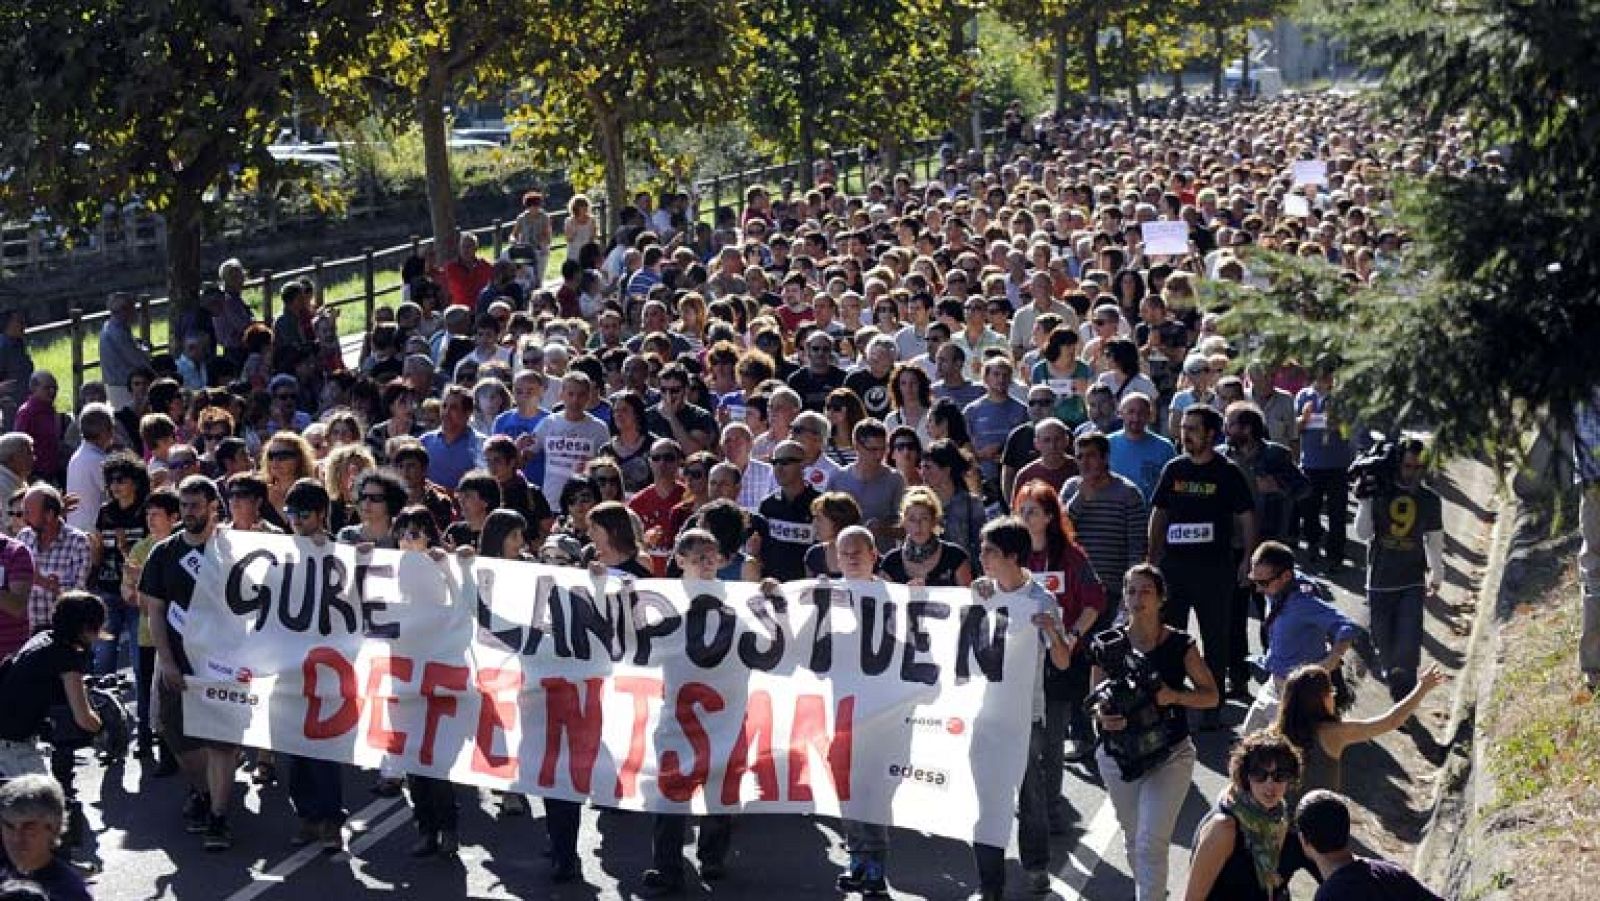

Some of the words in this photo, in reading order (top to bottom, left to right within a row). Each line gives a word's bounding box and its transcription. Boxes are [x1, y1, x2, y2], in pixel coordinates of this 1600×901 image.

[1390, 496, 1416, 537] 9
[225, 548, 401, 637] GURE
[476, 568, 1009, 685] LANPOSTUEN
[303, 646, 856, 806] DEFENTSAN
[889, 764, 946, 785] edesa
